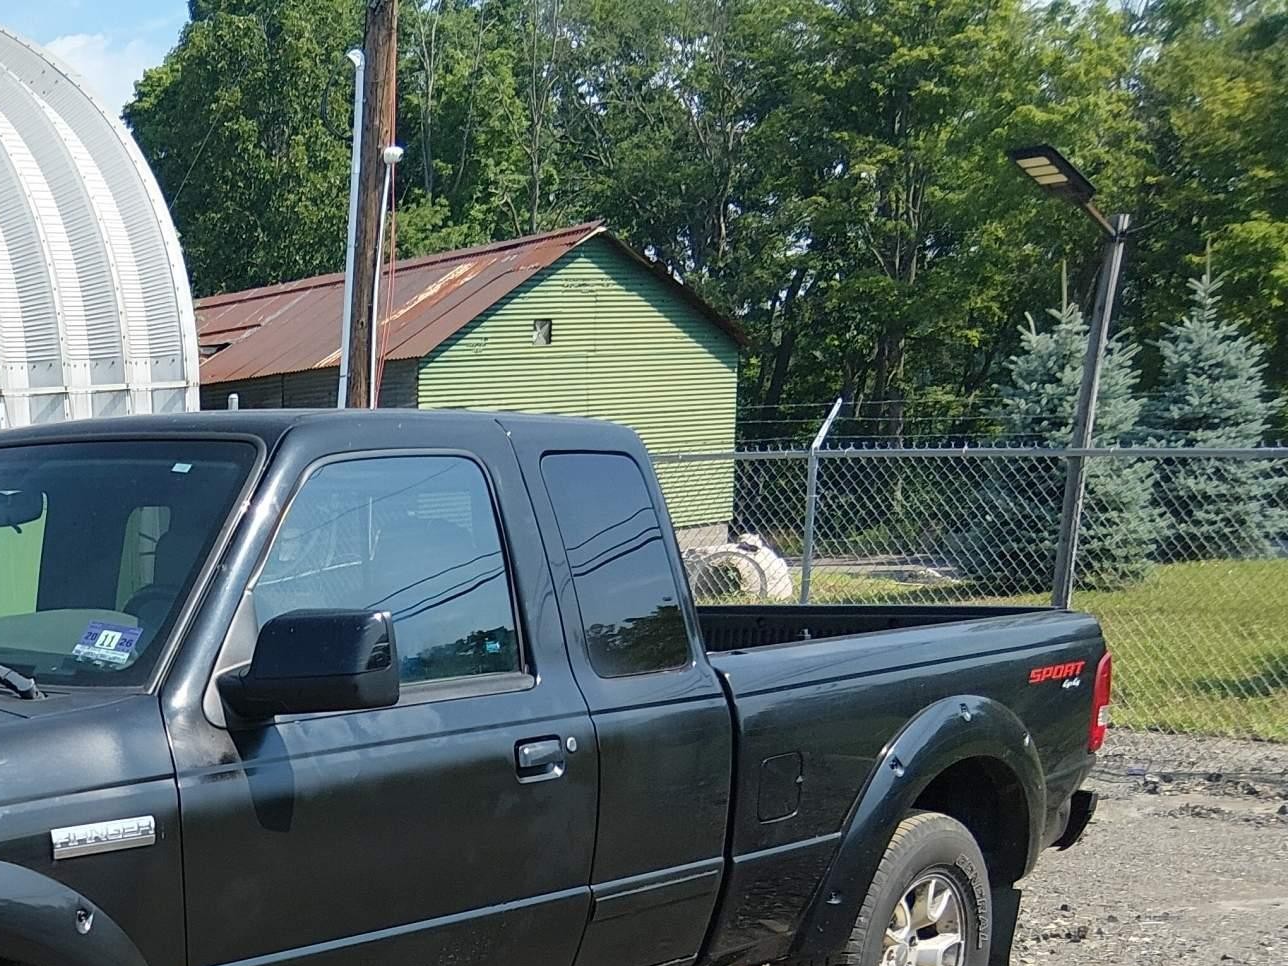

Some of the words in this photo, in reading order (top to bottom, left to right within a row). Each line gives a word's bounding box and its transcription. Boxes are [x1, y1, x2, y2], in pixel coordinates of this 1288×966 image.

[84, 631, 99, 641] 20
[99, 633, 116, 648] 11
[119, 638, 134, 648] 26
[1028, 660, 1086, 684] SPORT
